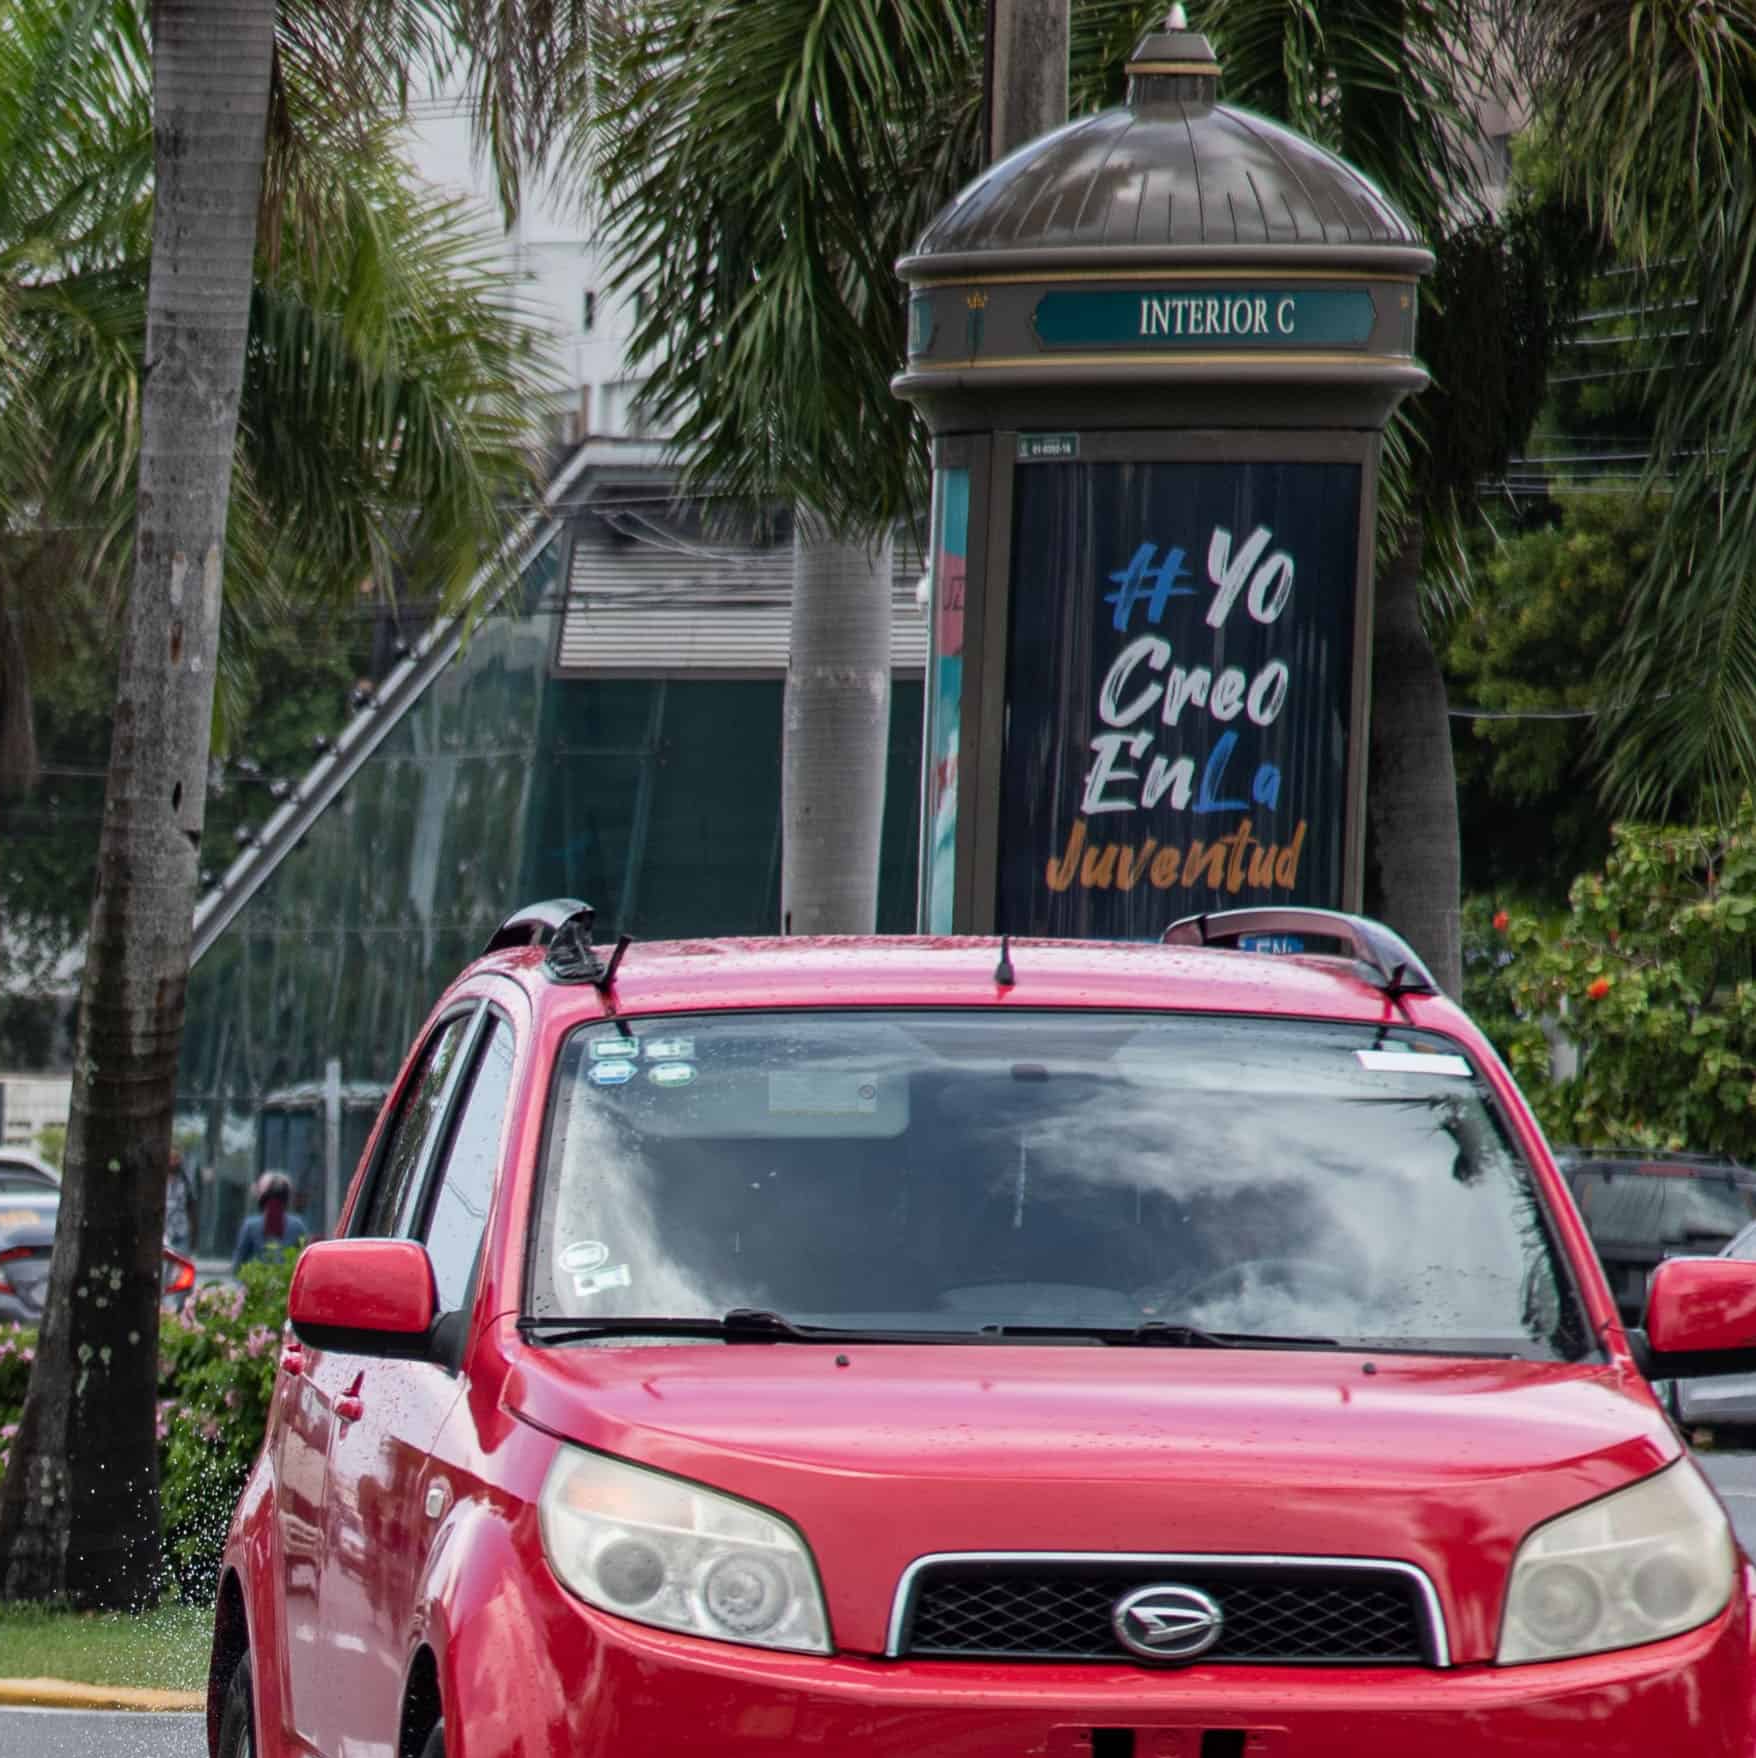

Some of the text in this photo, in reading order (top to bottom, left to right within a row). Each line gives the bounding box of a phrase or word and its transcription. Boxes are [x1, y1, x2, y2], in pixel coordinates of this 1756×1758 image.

[1139, 298, 1296, 335] INTERIOR C
[1098, 632, 1289, 728] Creo
[1045, 818, 1307, 893] Juventud
